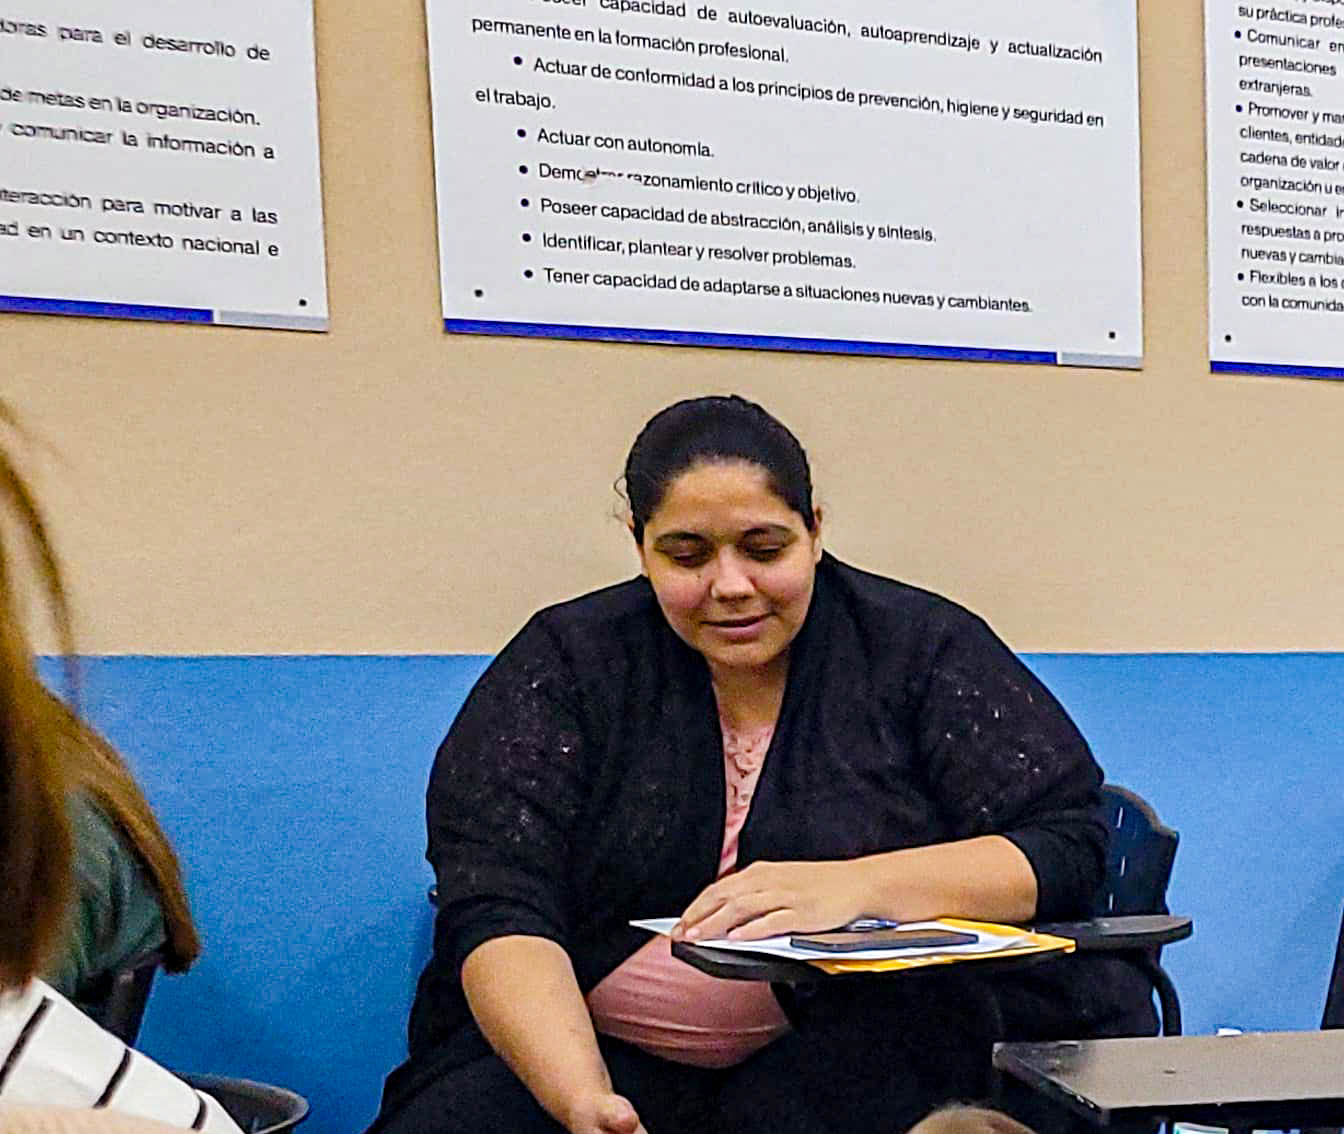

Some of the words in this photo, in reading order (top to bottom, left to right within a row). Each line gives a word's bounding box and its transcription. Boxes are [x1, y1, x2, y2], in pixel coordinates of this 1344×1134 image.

[57, 26, 103, 42] para
[113, 30, 130, 45] el
[141, 34, 235, 56] desarrollo
[246, 44, 269, 60] de
[472, 18, 570, 39] permanente
[574, 29, 594, 42] en
[598, 27, 611, 43] la
[698, 41, 788, 62] profesional.
[697, 6, 716, 20] de
[861, 25, 979, 51] autoaprendizaje
[990, 40, 998, 54] y
[26, 91, 85, 108] metas
[87, 97, 112, 111] en
[115, 96, 132, 112] la
[475, 87, 489, 102] el
[493, 88, 555, 110] trabajo.
[533, 57, 587, 76] Actuar
[590, 64, 611, 78] de
[615, 68, 714, 88] conformidad
[718, 79, 728, 90] a
[732, 76, 754, 92] los
[758, 81, 832, 100] principios
[836, 88, 854, 102] de
[947, 99, 998, 116] higiene
[1001, 106, 1009, 120] y
[1013, 108, 1082, 124] seguridad
[1086, 115, 1103, 127] en
[10, 123, 113, 143] comunicar
[122, 130, 138, 147] la
[263, 147, 274, 158] a
[537, 128, 590, 146] Actuar
[594, 136, 623, 149] con
[785, 186, 794, 199] y
[797, 184, 859, 202] objetivo.
[101, 198, 144, 213] para
[153, 202, 222, 218] motivar
[230, 209, 241, 221] a
[252, 207, 277, 224] las
[541, 198, 597, 216] Poseer
[600, 206, 683, 222] capacidad
[687, 209, 706, 224] de
[866, 225, 874, 239] y
[26, 225, 51, 238] en
[60, 229, 84, 240] un
[93, 230, 173, 248] contexto
[181, 237, 258, 254] nacional
[268, 244, 278, 256] e
[542, 232, 624, 254] Identificar,
[628, 239, 692, 256] plantear
[695, 246, 704, 260] y
[708, 246, 768, 262] resolver
[772, 251, 855, 268] problemas.
[543, 267, 589, 284] Tener
[592, 274, 676, 289] capacidad
[680, 276, 699, 291] de
[703, 278, 779, 295] adaptarse
[783, 286, 792, 296] a
[795, 285, 879, 302] situaciones
[883, 292, 934, 306] nuevas
[936, 296, 945, 309] y
[947, 295, 1031, 312] cambiantes.
